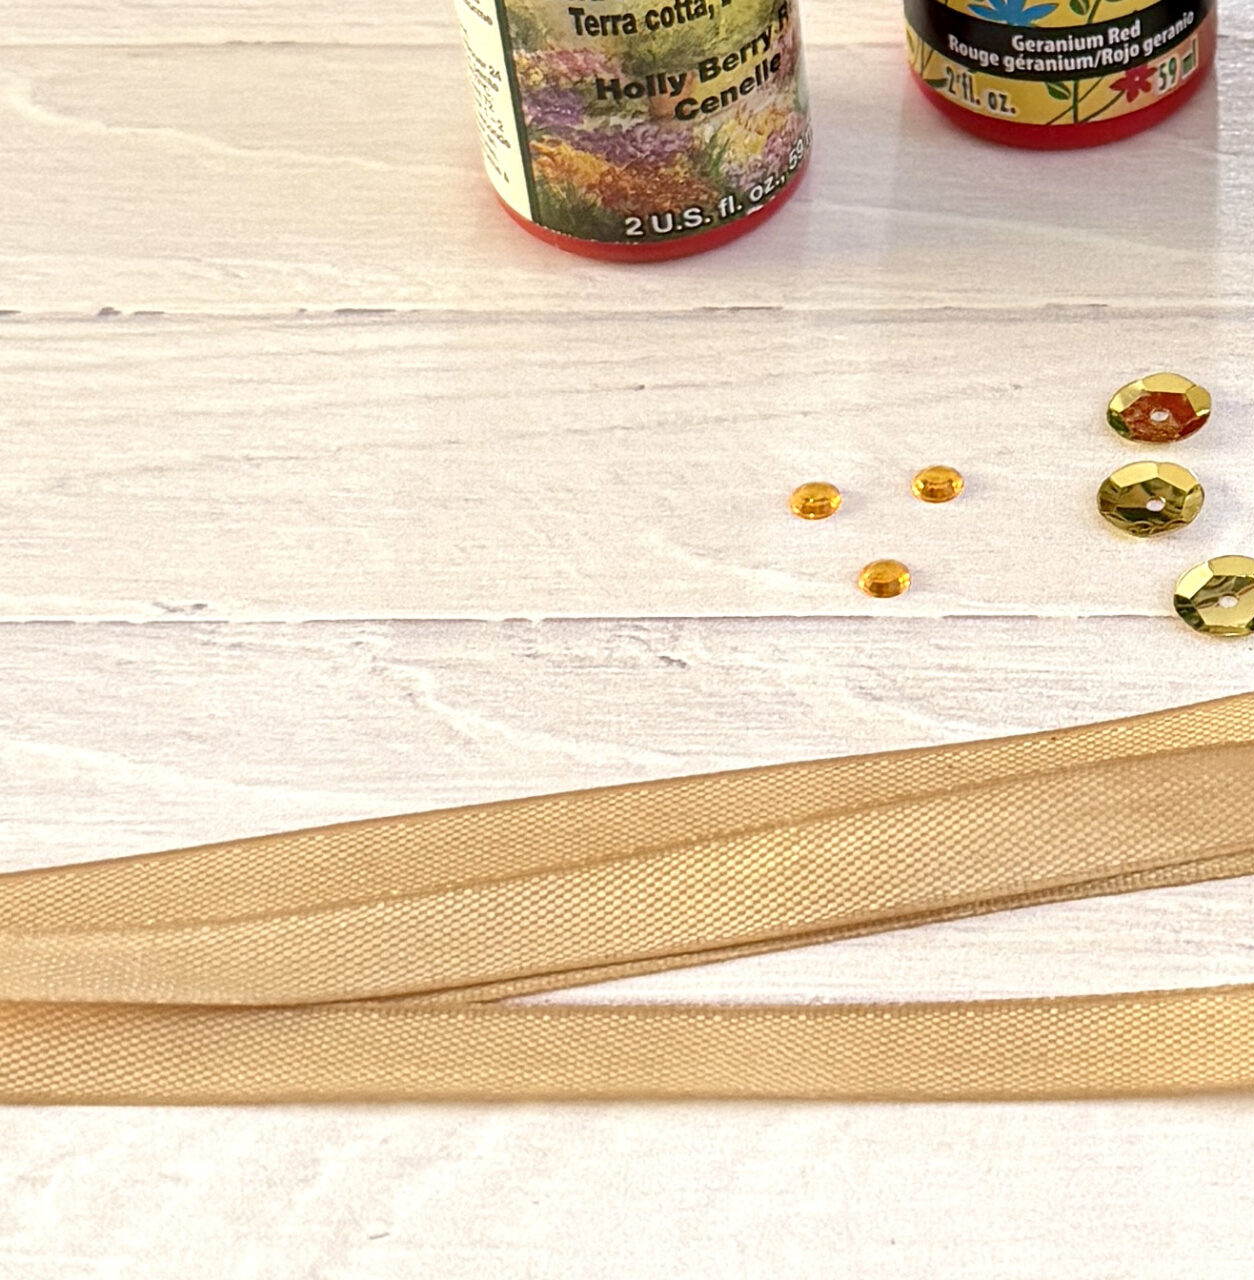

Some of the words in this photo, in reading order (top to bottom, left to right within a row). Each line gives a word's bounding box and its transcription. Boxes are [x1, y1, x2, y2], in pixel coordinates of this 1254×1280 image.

[569, 7, 638, 36] Terra
[1011, 32, 1104, 54] Geranium
[1108, 18, 1142, 46] Red
[947, 33, 1000, 68] Rouge
[1003, 41, 1140, 73] géranium/Rojo
[1142, 10, 1195, 56] geranio
[596, 69, 688, 101] Holly
[697, 27, 773, 84] Berry
[1158, 56, 1178, 92] 59
[674, 51, 782, 122] Cenelle
[987, 91, 1017, 114] oz.
[625, 216, 644, 237] 2
[651, 207, 712, 234] U.S.
[718, 195, 743, 219] fl.
